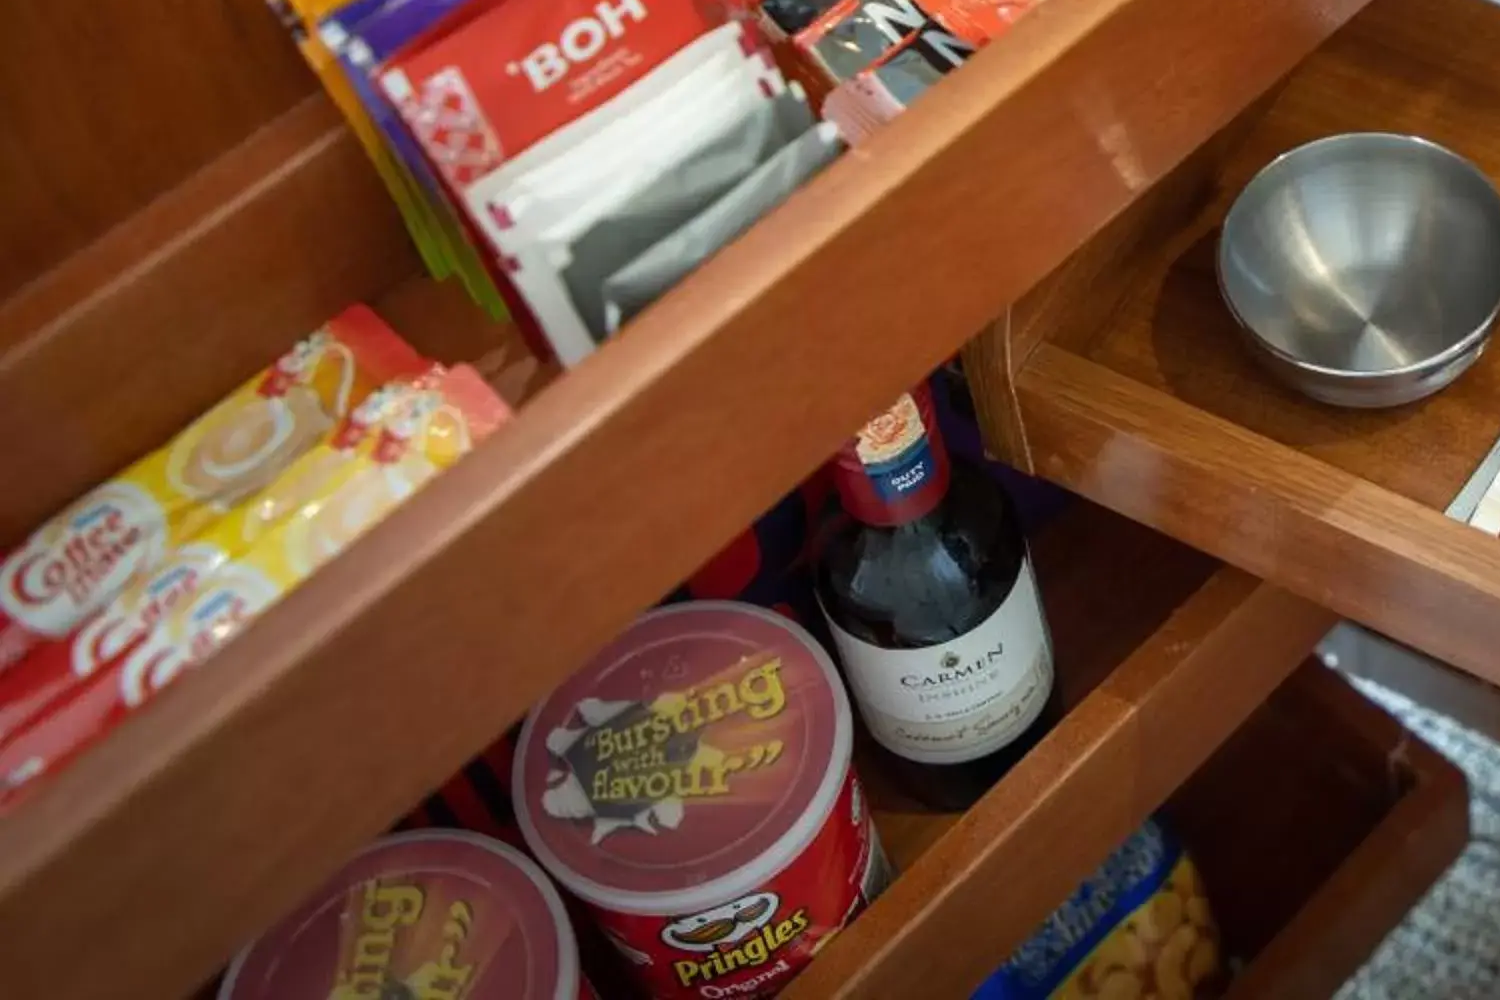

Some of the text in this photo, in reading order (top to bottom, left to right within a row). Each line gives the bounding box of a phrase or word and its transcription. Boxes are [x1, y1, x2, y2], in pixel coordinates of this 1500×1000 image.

[900, 642, 1003, 688] CARMEN
[612, 750, 666, 773] with
[673, 908, 809, 988] Pringles
[700, 959, 791, 999] Original
